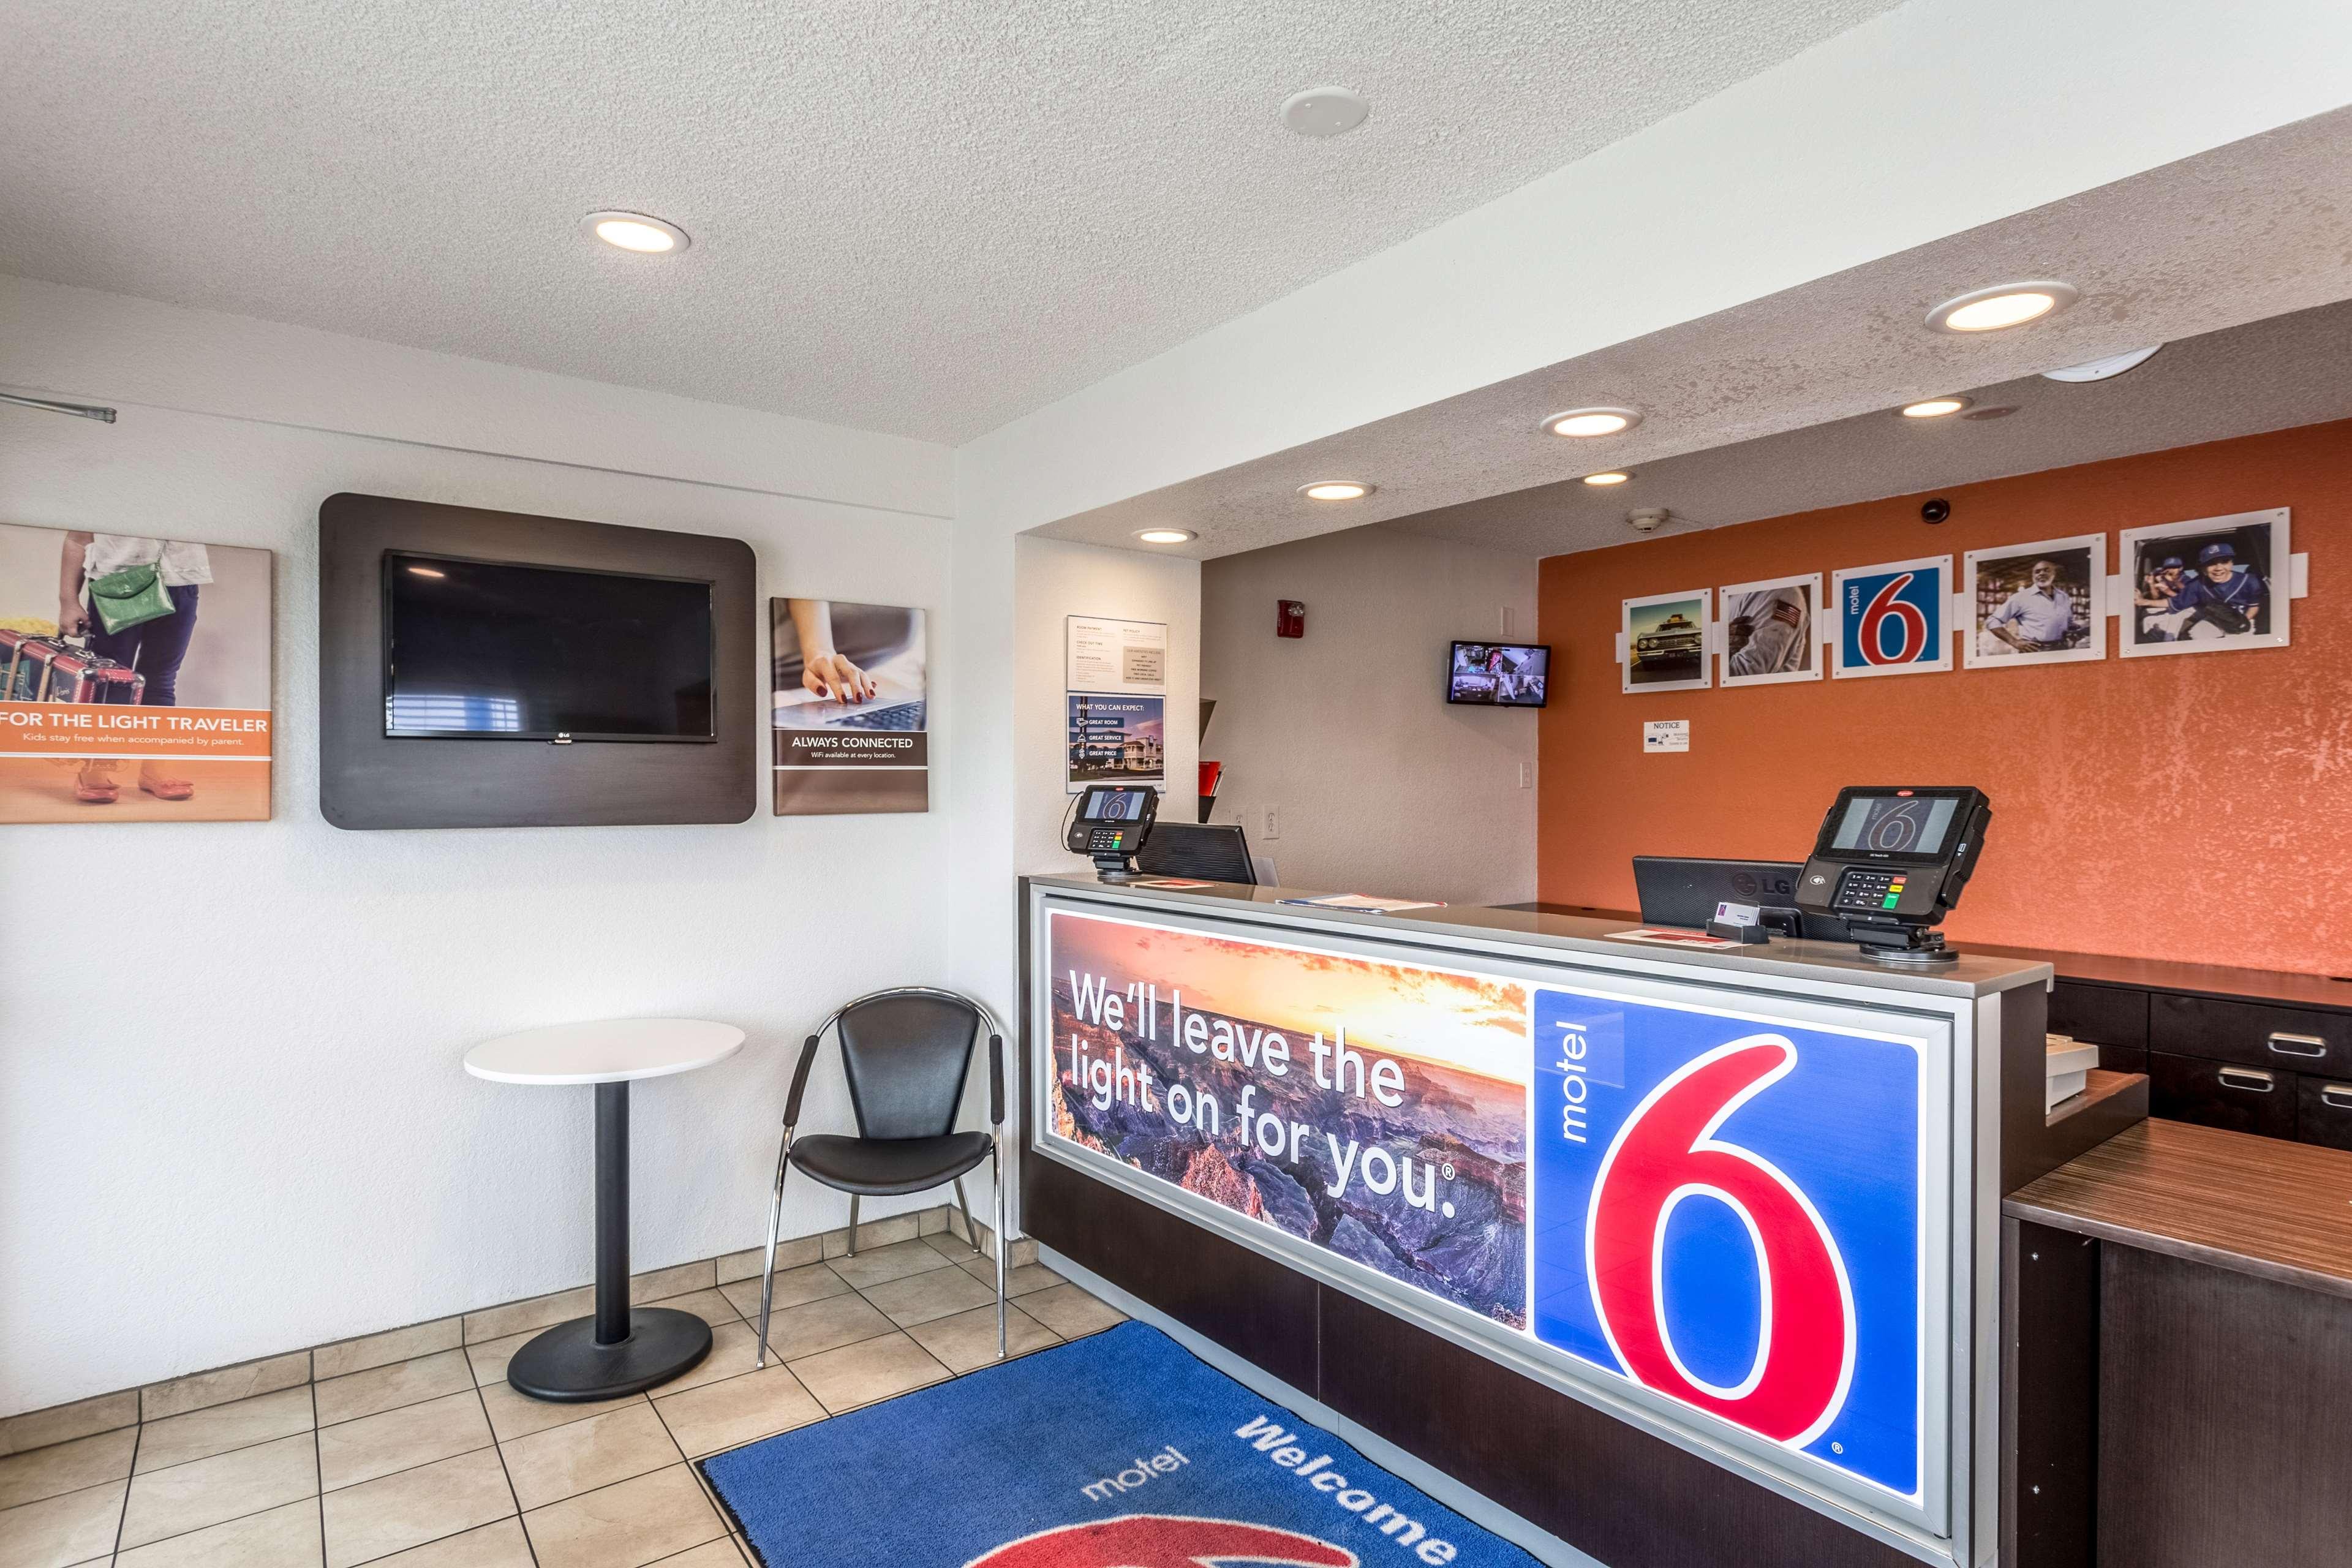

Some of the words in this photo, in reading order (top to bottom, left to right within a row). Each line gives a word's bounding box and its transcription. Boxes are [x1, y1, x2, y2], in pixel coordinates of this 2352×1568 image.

[1849, 585, 1860, 615] motel
[1858, 572, 1928, 666] 6
[0, 712, 43, 726] FOR
[48, 713, 92, 728] THE
[99, 714, 161, 729] LIGHT
[166, 717, 268, 733] TRAVELER
[23, 733, 47, 741] Kids
[49, 734, 71, 744] stay
[74, 733, 94, 742] free
[97, 734, 125, 743] when
[128, 736, 194, 746] accompanied
[197, 736, 209, 747] by
[211, 738, 244, 747] parent.
[791, 737, 839, 748] ALWAYS
[842, 737, 913, 748] CONNECTED
[1102, 792, 1127, 820] 6
[1868, 800, 1919, 851] 6
[1762, 878, 1790, 895] LG
[1068, 969, 1156, 1042] We'll
[1172, 989, 1291, 1077] leave
[1308, 1025, 1407, 1109] the
[1071, 1033, 1153, 1114] light
[1167, 1082, 1219, 1136] on
[1235, 1084, 1310, 1164] for
[1556, 1020, 1588, 1145] motel
[1585, 1033, 1858, 1452] 6
[1080, 1445, 1191, 1502] motel
[1234, 1413, 1458, 1566] Welcome
